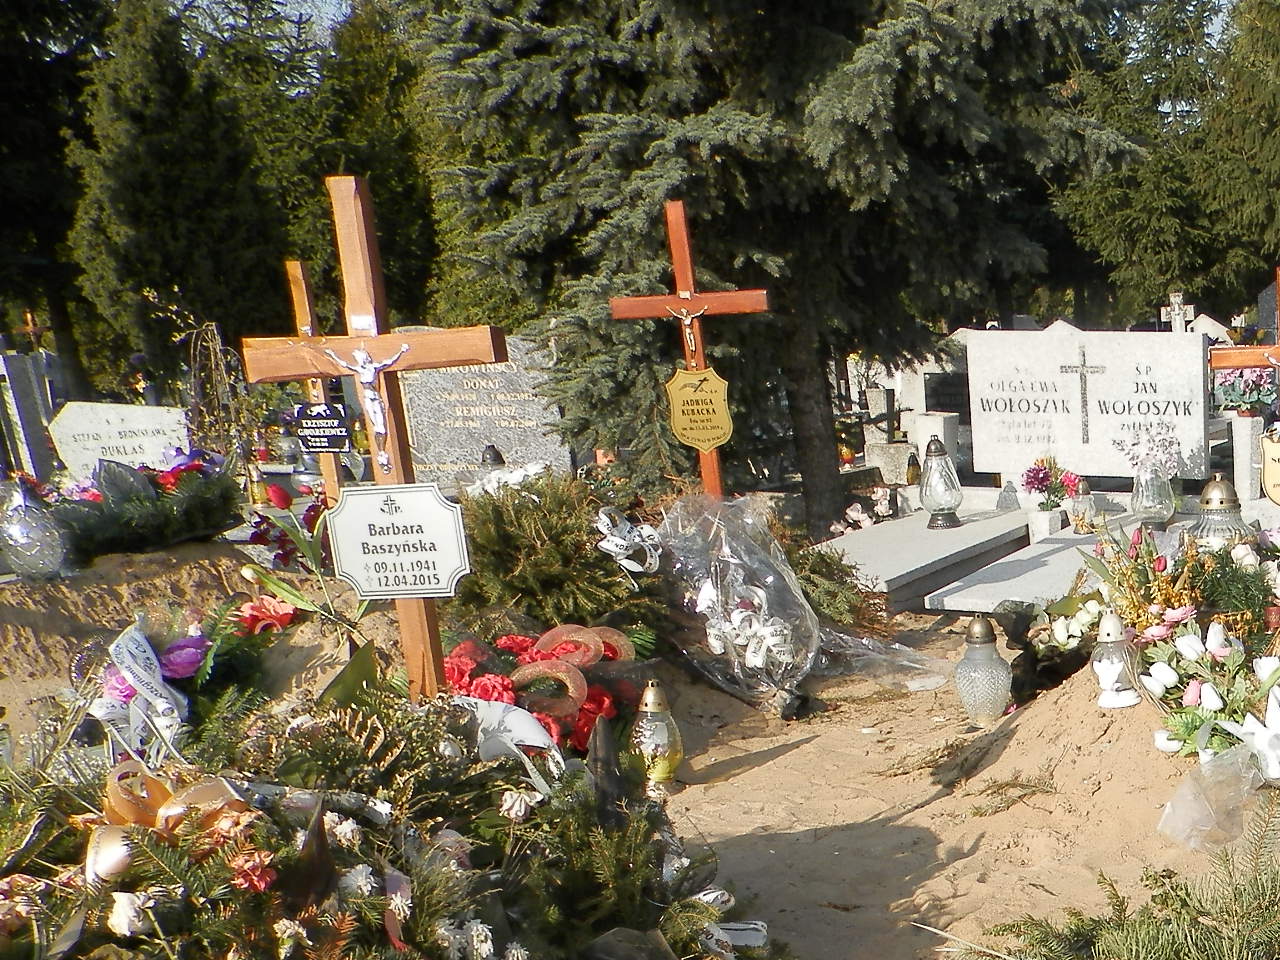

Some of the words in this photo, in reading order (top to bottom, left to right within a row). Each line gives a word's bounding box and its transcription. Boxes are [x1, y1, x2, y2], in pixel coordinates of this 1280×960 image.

[463, 379, 502, 390] DONAT
[1133, 381, 1158, 394] JAN
[682, 398, 714, 407] JADWIGA
[980, 397, 1070, 414] WOŁOSZYK
[1098, 400, 1193, 417] WOŁOSZYK
[455, 406, 517, 417] REMIGIUSZ
[368, 522, 425, 537] Barbara
[361, 540, 438, 557] Baszyńska
[374, 560, 437, 574] 09.11.1941
[377, 573, 441, 588] 12.04.2015
